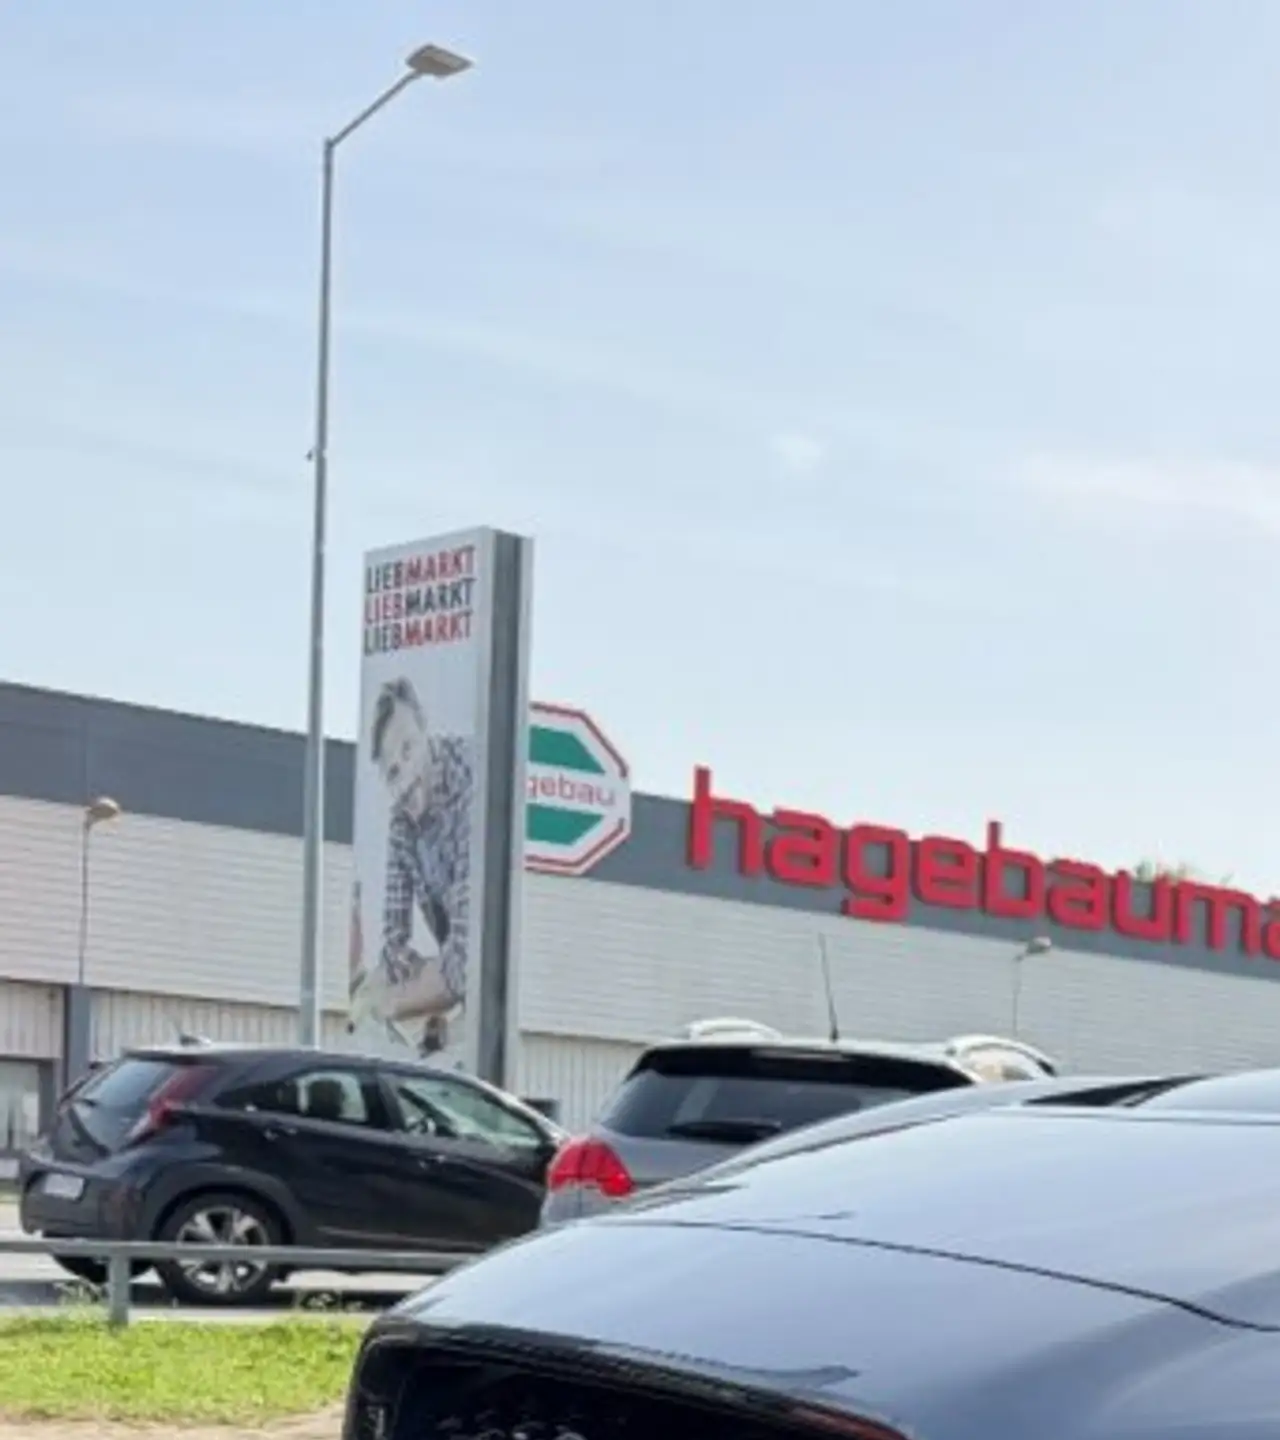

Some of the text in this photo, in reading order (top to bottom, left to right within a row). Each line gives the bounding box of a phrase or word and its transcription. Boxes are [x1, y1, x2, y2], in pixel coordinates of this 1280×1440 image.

[365, 545, 475, 594] LIEBMARKT
[364, 576, 476, 625] LIEBMARKT
[363, 609, 473, 657] LIEBMARKT
